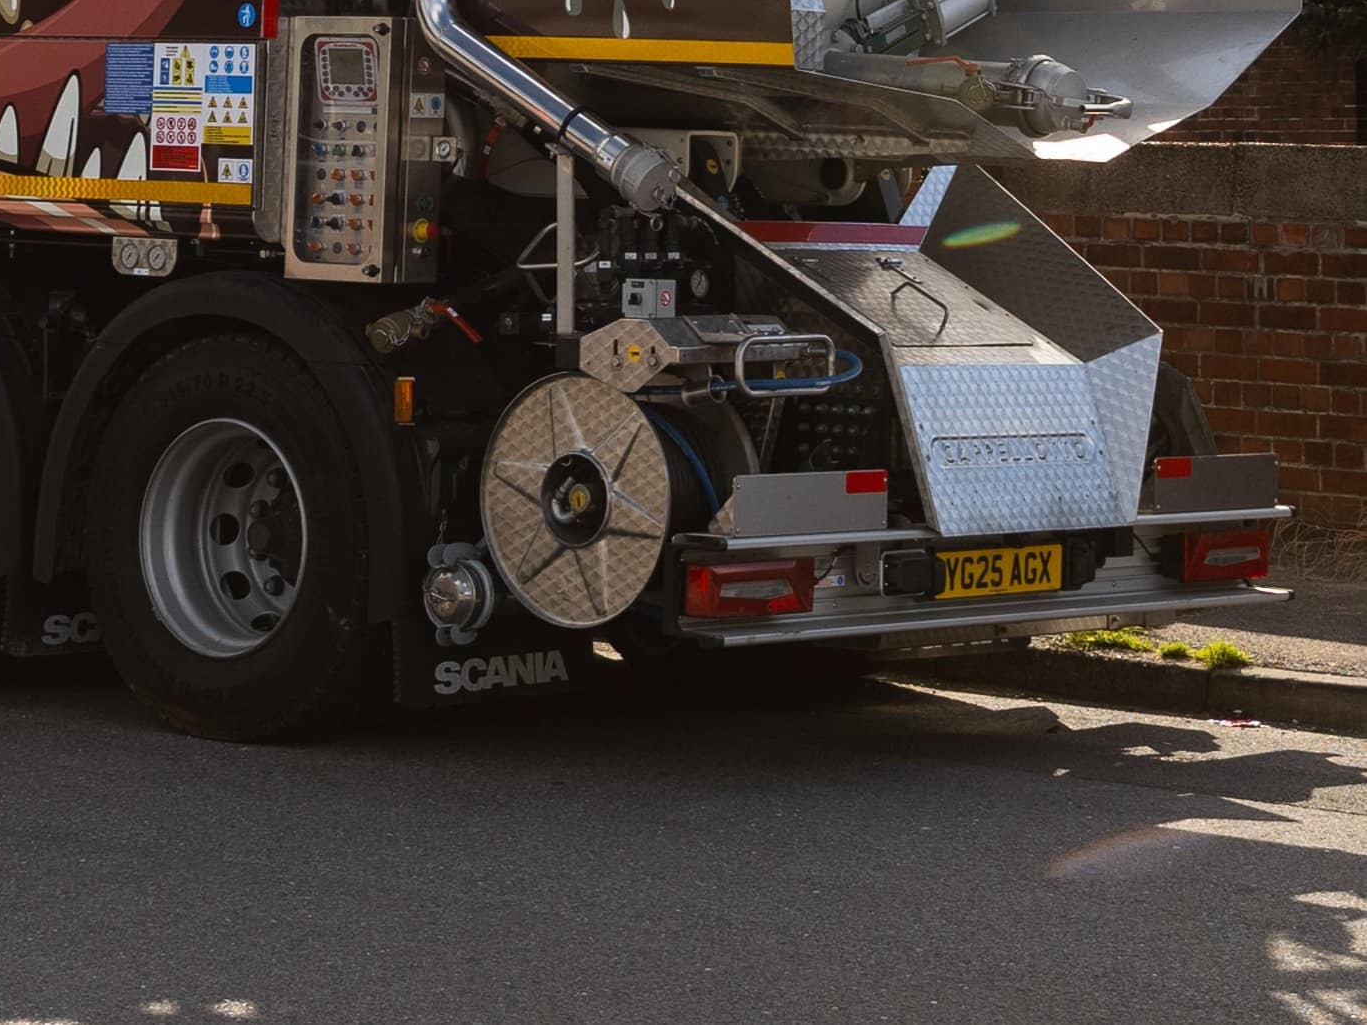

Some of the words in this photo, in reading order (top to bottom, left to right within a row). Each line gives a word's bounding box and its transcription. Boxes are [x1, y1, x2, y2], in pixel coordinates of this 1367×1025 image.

[945, 554, 1003, 592] YG25
[1010, 550, 1052, 587] AGX
[433, 649, 570, 695] SCANIA
